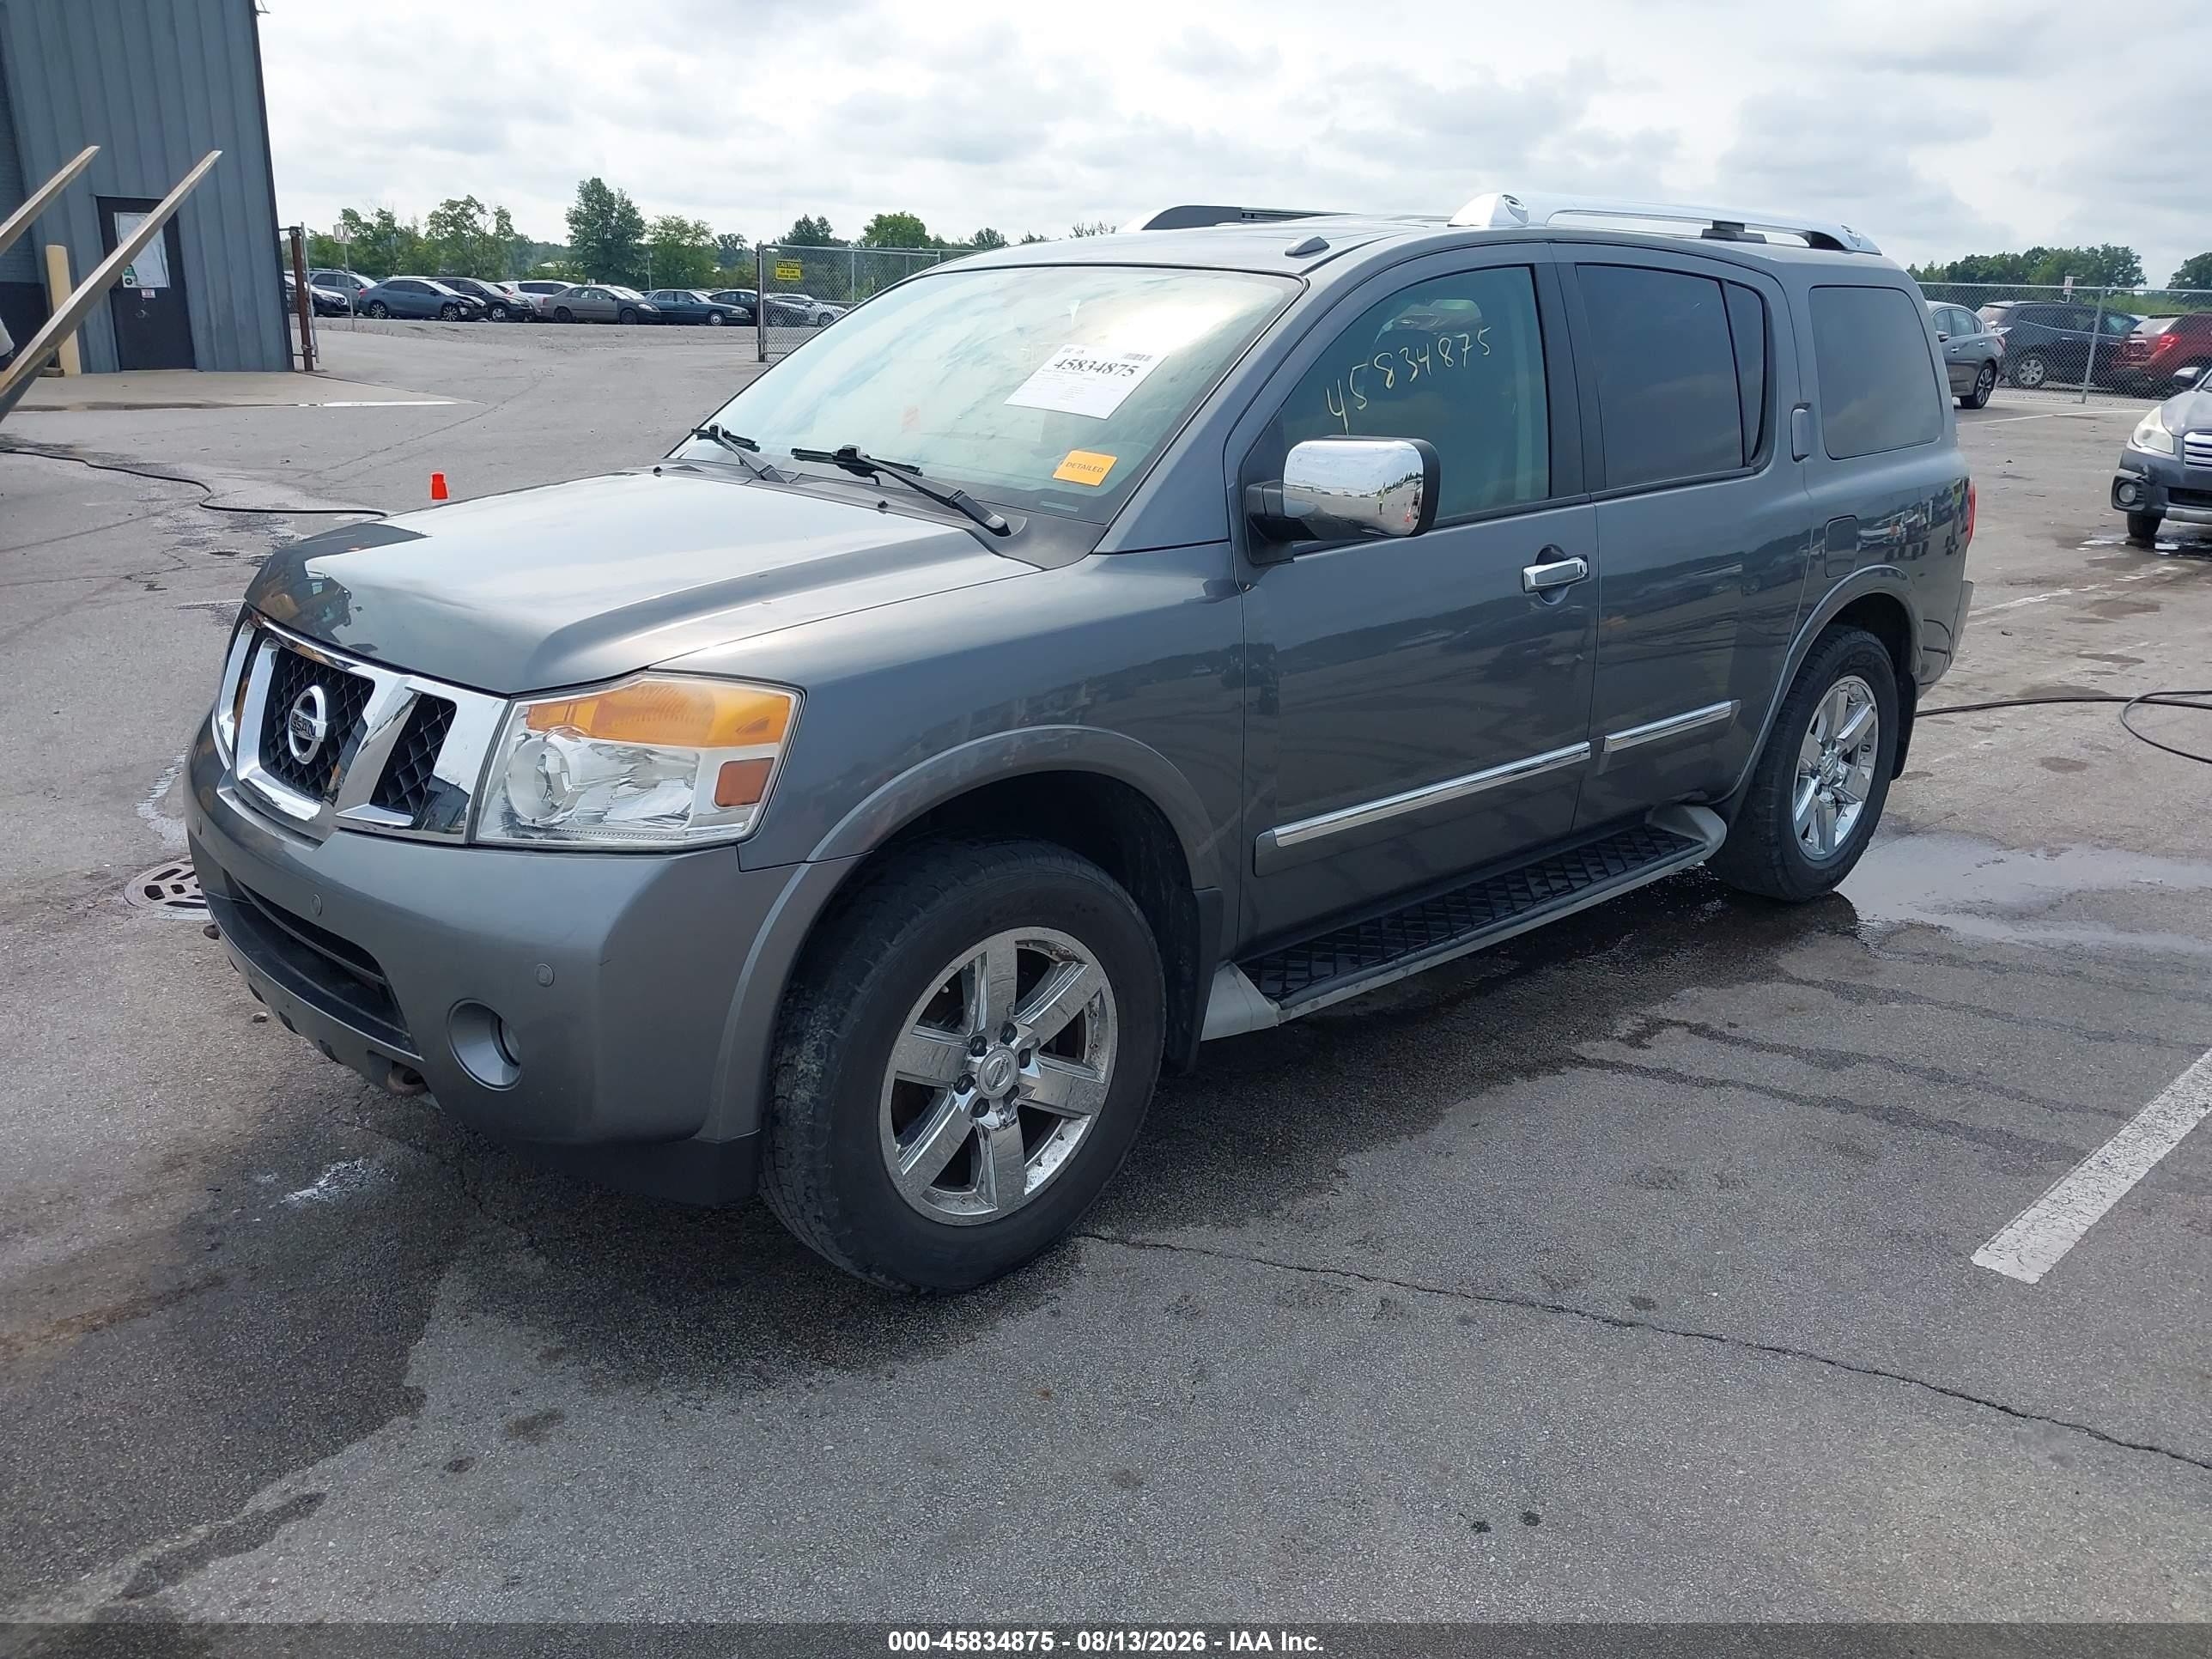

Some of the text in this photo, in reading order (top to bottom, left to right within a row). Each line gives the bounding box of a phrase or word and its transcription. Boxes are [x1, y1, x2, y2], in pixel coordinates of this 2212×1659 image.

[1053, 358, 1140, 377] 45834875
[1326, 326, 1491, 436] 45834875
[1066, 461, 1104, 473] DETAILED
